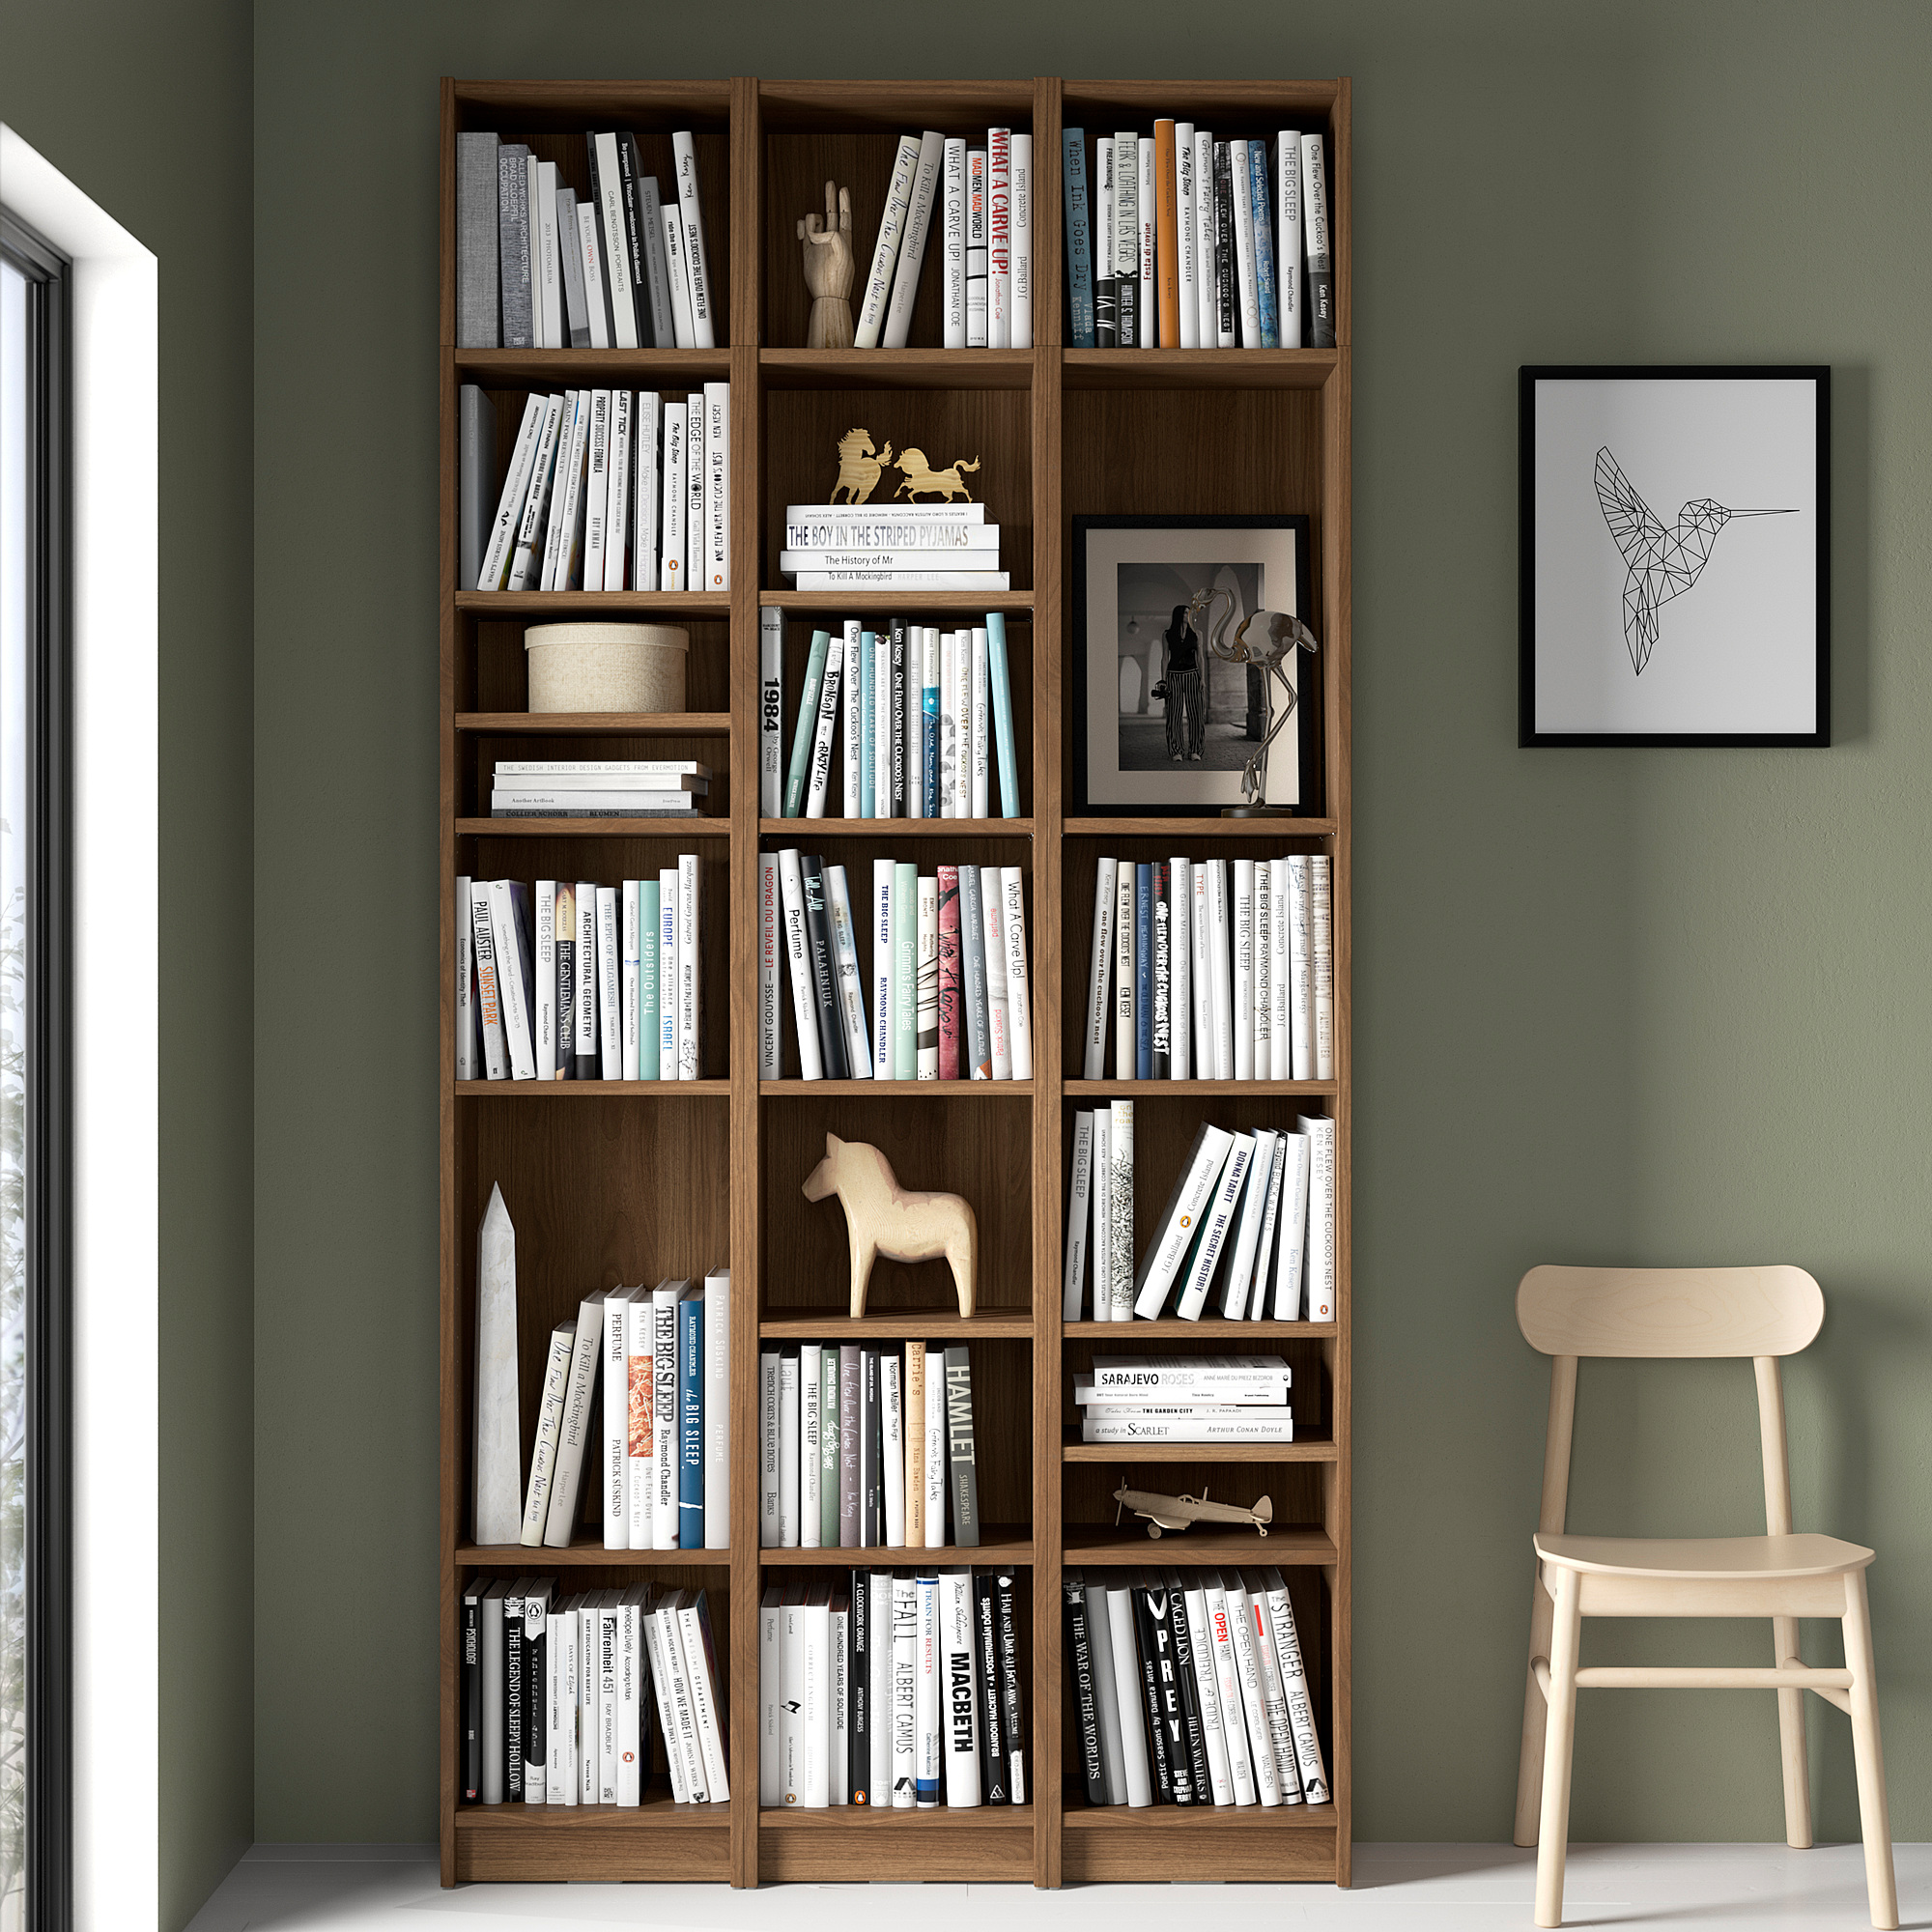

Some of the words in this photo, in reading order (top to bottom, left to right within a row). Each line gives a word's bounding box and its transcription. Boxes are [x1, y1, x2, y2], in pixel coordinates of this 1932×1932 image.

[509, 157, 518, 180] BRAD
[923, 162, 934, 174] To
[992, 131, 1008, 175] WHAT
[1068, 139, 1083, 176] When
[1285, 146, 1296, 166] THE
[500, 157, 509, 212] OCCUPATION
[518, 157, 526, 185] ALLIED
[921, 176, 931, 192] Kill
[992, 180, 1008, 189] A
[1285, 169, 1296, 187] BIG
[510, 183, 519, 222] CLOEPFIL
[1071, 185, 1085, 210] Ink
[1285, 189, 1296, 221] SLEEP
[907, 202, 926, 260] Mockingbird
[992, 194, 1009, 244] CARVE
[520, 219, 529, 283] ARCHITECTURE
[610, 210, 620, 251] BENGTSSON
[615, 254, 624, 292] PORTRAITS
[1072, 219, 1087, 255] Goes
[992, 248, 1009, 274] UP!
[1074, 265, 1089, 291] Dry
[1071, 297, 1084, 340] Kenniff
[1084, 302, 1093, 333] Vlada
[595, 396, 606, 423] PROPERTY
[618, 391, 627, 413] LAST
[595, 424, 605, 447] SUCCESS
[618, 416, 627, 436] TICK
[593, 448, 604, 473] FORMULA
[592, 518, 601, 529] ROY
[788, 526, 810, 547] THE
[811, 526, 833, 547] BOY
[835, 526, 849, 547] IN
[850, 526, 871, 547] THE
[873, 526, 916, 547] STRIPED
[919, 526, 969, 547] PYJAMAS
[591, 530, 601, 549] INMAN
[824, 554, 840, 566] The
[840, 554, 870, 568] History
[871, 554, 881, 566] of
[881, 554, 894, 566] Mr
[850, 627, 859, 643] One
[850, 646, 859, 664] Flew
[850, 667, 859, 686] Over
[764, 677, 780, 732] 1984
[850, 689, 859, 703] The
[850, 706, 859, 740] Cuckoo's
[772, 736, 780, 745] by
[850, 743, 859, 760] Nest
[771, 747, 780, 773] George
[849, 782, 858, 798] Kesey
[803, 872, 825, 912] Tell-All
[1260, 873, 1268, 891] THE
[473, 900, 489, 925] PAUL
[1260, 894, 1268, 909] BIG
[662, 907, 673, 948] EUROPE
[788, 909, 803, 959] Perfume
[1260, 911, 1268, 941] SLEEP
[476, 926, 493, 960] AUSTER
[582, 911, 591, 985] ARCHITECTURAL
[645, 932, 654, 990] Outsiders
[815, 940, 833, 1008] PALAHNIUK
[900, 941, 914, 980] Grimm's
[1260, 943, 1268, 988] RAYMOND
[479, 966, 496, 1000] SUNSET
[879, 977, 888, 1017] RAYMOND
[899, 982, 914, 1006] Fairy
[482, 1002, 498, 1026] PARK
[582, 988, 591, 1038] GEOMETRY
[644, 994, 654, 1014] The
[901, 1008, 914, 1031] Tales
[1260, 990, 1268, 1040] CHANDLER
[662, 1015, 673, 1052] ISRAEL
[1232, 1151, 1247, 1178] DONNA
[1223, 1179, 1239, 1204] TARTT
[1216, 1214, 1227, 1228] THE
[1206, 1229, 1222, 1258] SECRET
[1194, 1258, 1213, 1293] HISTORY
[611, 1314, 622, 1362] PERFUME
[655, 1306, 674, 1340] THE
[655, 1341, 674, 1370] BIG
[911, 1345, 923, 1396] Carrie's
[889, 1362, 897, 1389] Norman
[1101, 1373, 1159, 1386] SARAJEVO
[655, 1372, 674, 1422] SLEEP
[890, 1391, 898, 1412] Mailer
[947, 1366, 976, 1465] HAMLET
[1101, 1427, 1120, 1436] study
[612, 1439, 621, 1477] PATRICK
[659, 1429, 670, 1466] Raymond
[612, 1478, 624, 1517] SÜSKIND
[660, 1468, 670, 1506] Chandler
[959, 1474, 971, 1525] SHAKESPEARE
[856, 1589, 865, 1626] CLOCKWORK
[1169, 1592, 1188, 1634] CAGED
[508, 1627, 521, 1650] THE
[856, 1627, 865, 1653] ORANGE
[1072, 1614, 1085, 1639] THE
[1214, 1612, 1229, 1642] OPEN
[1271, 1603, 1303, 1679] STRANGER
[466, 1629, 476, 1664] PSYCHOLOGY
[602, 1617, 614, 1673] Fahrenheit
[1075, 1641, 1089, 1671] WAR
[1176, 1635, 1191, 1666] LION
[508, 1651, 521, 1691] LEGEND
[603, 1676, 614, 1694] 451
[895, 1662, 914, 1708] ALBERT
[1079, 1673, 1091, 1691] OF
[508, 1693, 521, 1707] OF
[951, 1652, 974, 1752] MACBETH
[1081, 1693, 1094, 1720] THE
[1290, 1690, 1310, 1729] ALBERT
[508, 1708, 521, 1745] SLEEPY
[895, 1714, 914, 1754] CAMUS
[1084, 1726, 1100, 1779] WORLDS
[1297, 1733, 1318, 1767] CAMUS
[508, 1746, 521, 1792] HOLLOW
